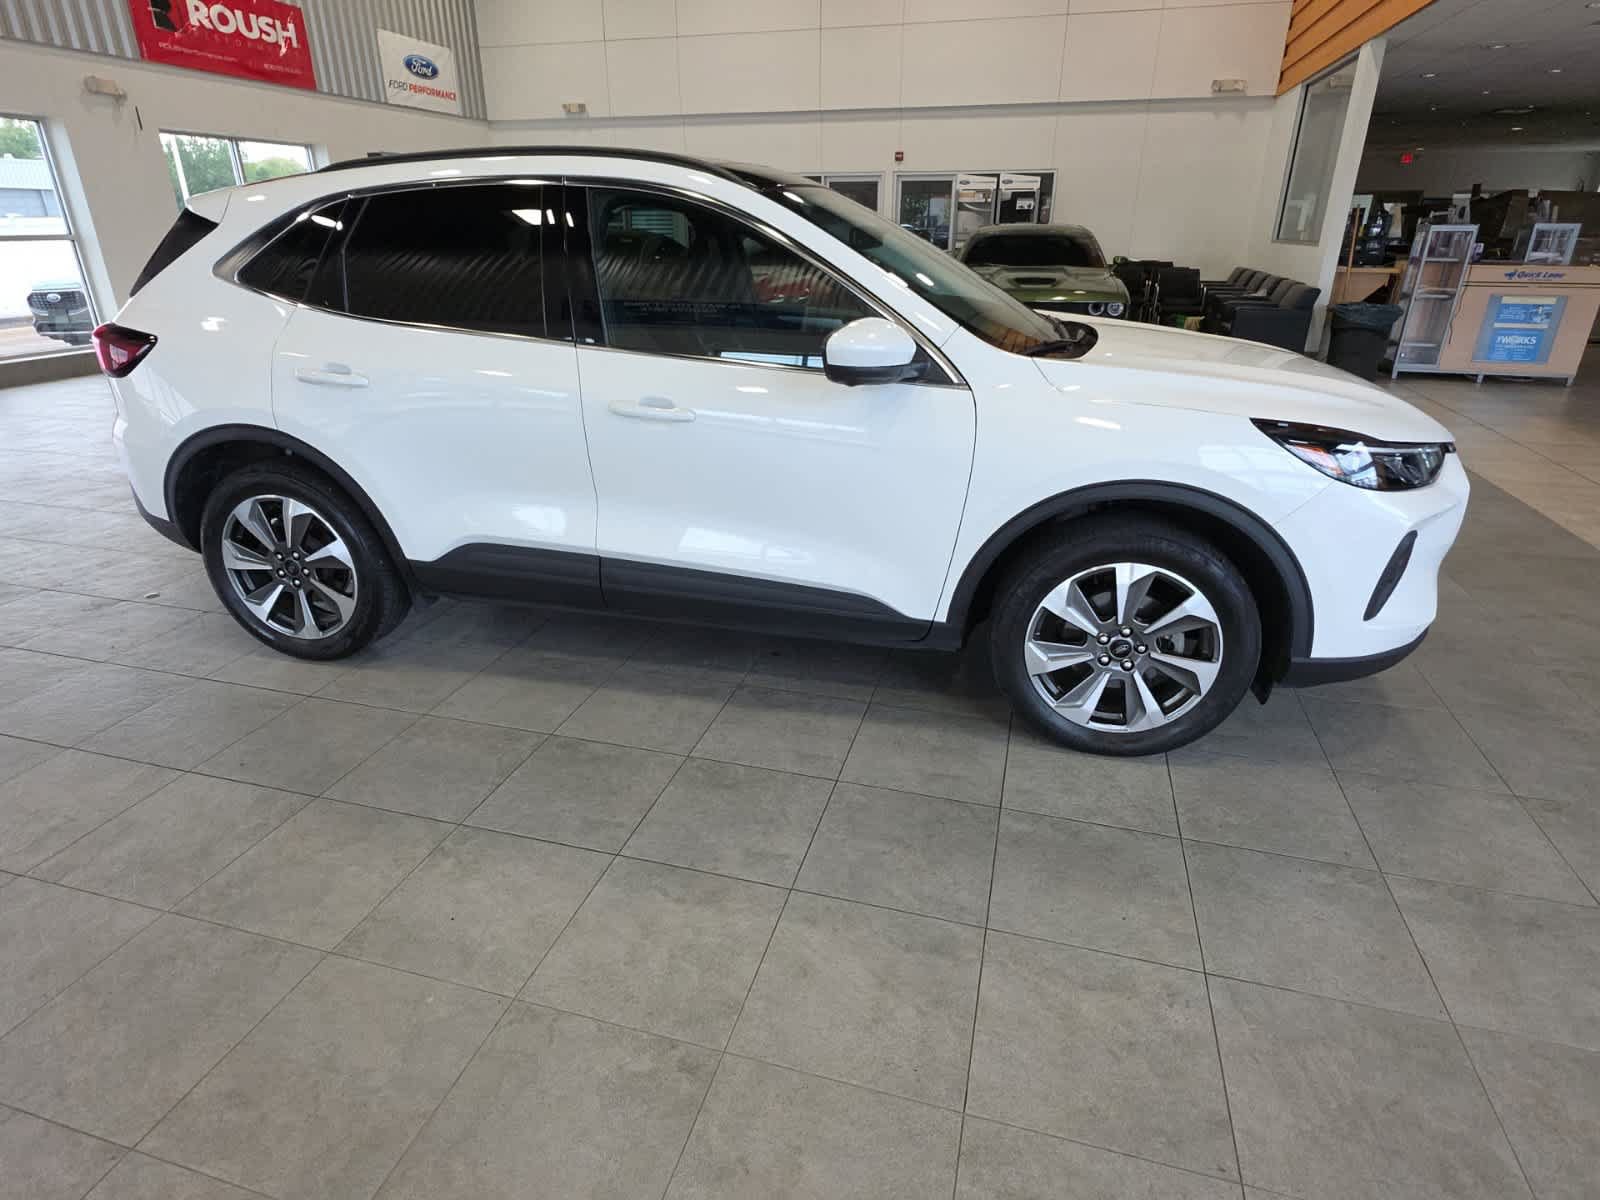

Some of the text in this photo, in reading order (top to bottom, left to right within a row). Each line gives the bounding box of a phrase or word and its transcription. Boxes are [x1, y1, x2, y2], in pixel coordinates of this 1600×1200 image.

[186, 0, 299, 49] ROUSH
[410, 57, 433, 76] Ford
[388, 79, 408, 91] FORD
